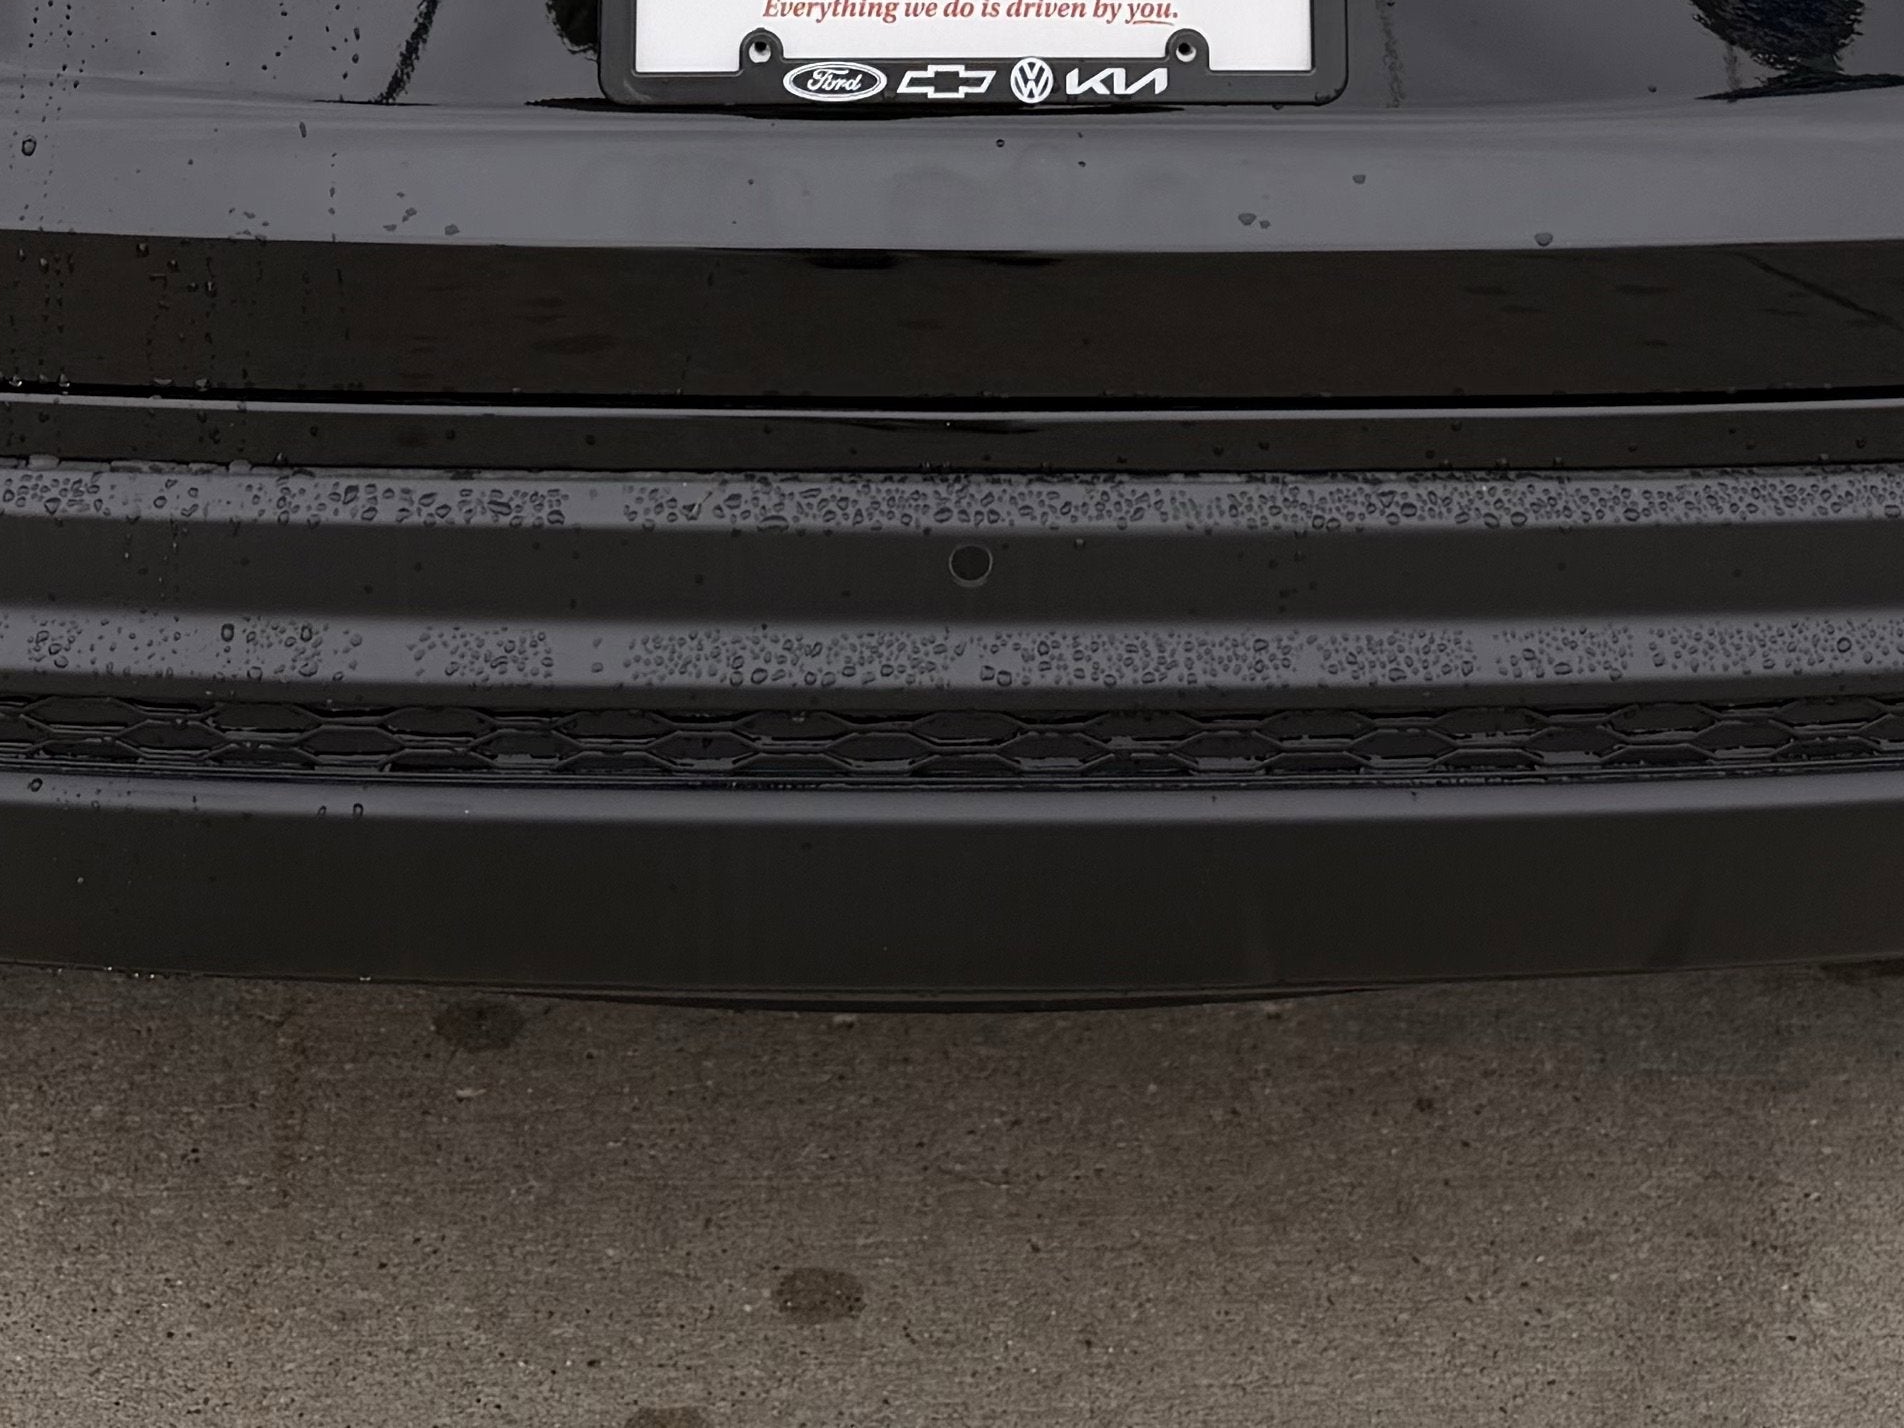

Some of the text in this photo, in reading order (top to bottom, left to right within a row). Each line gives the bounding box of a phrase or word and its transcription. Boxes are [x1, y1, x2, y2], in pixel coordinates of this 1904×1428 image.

[904, 2, 938, 18] we
[1125, 2, 1178, 25] you.
[806, 69, 862, 93] Ford
